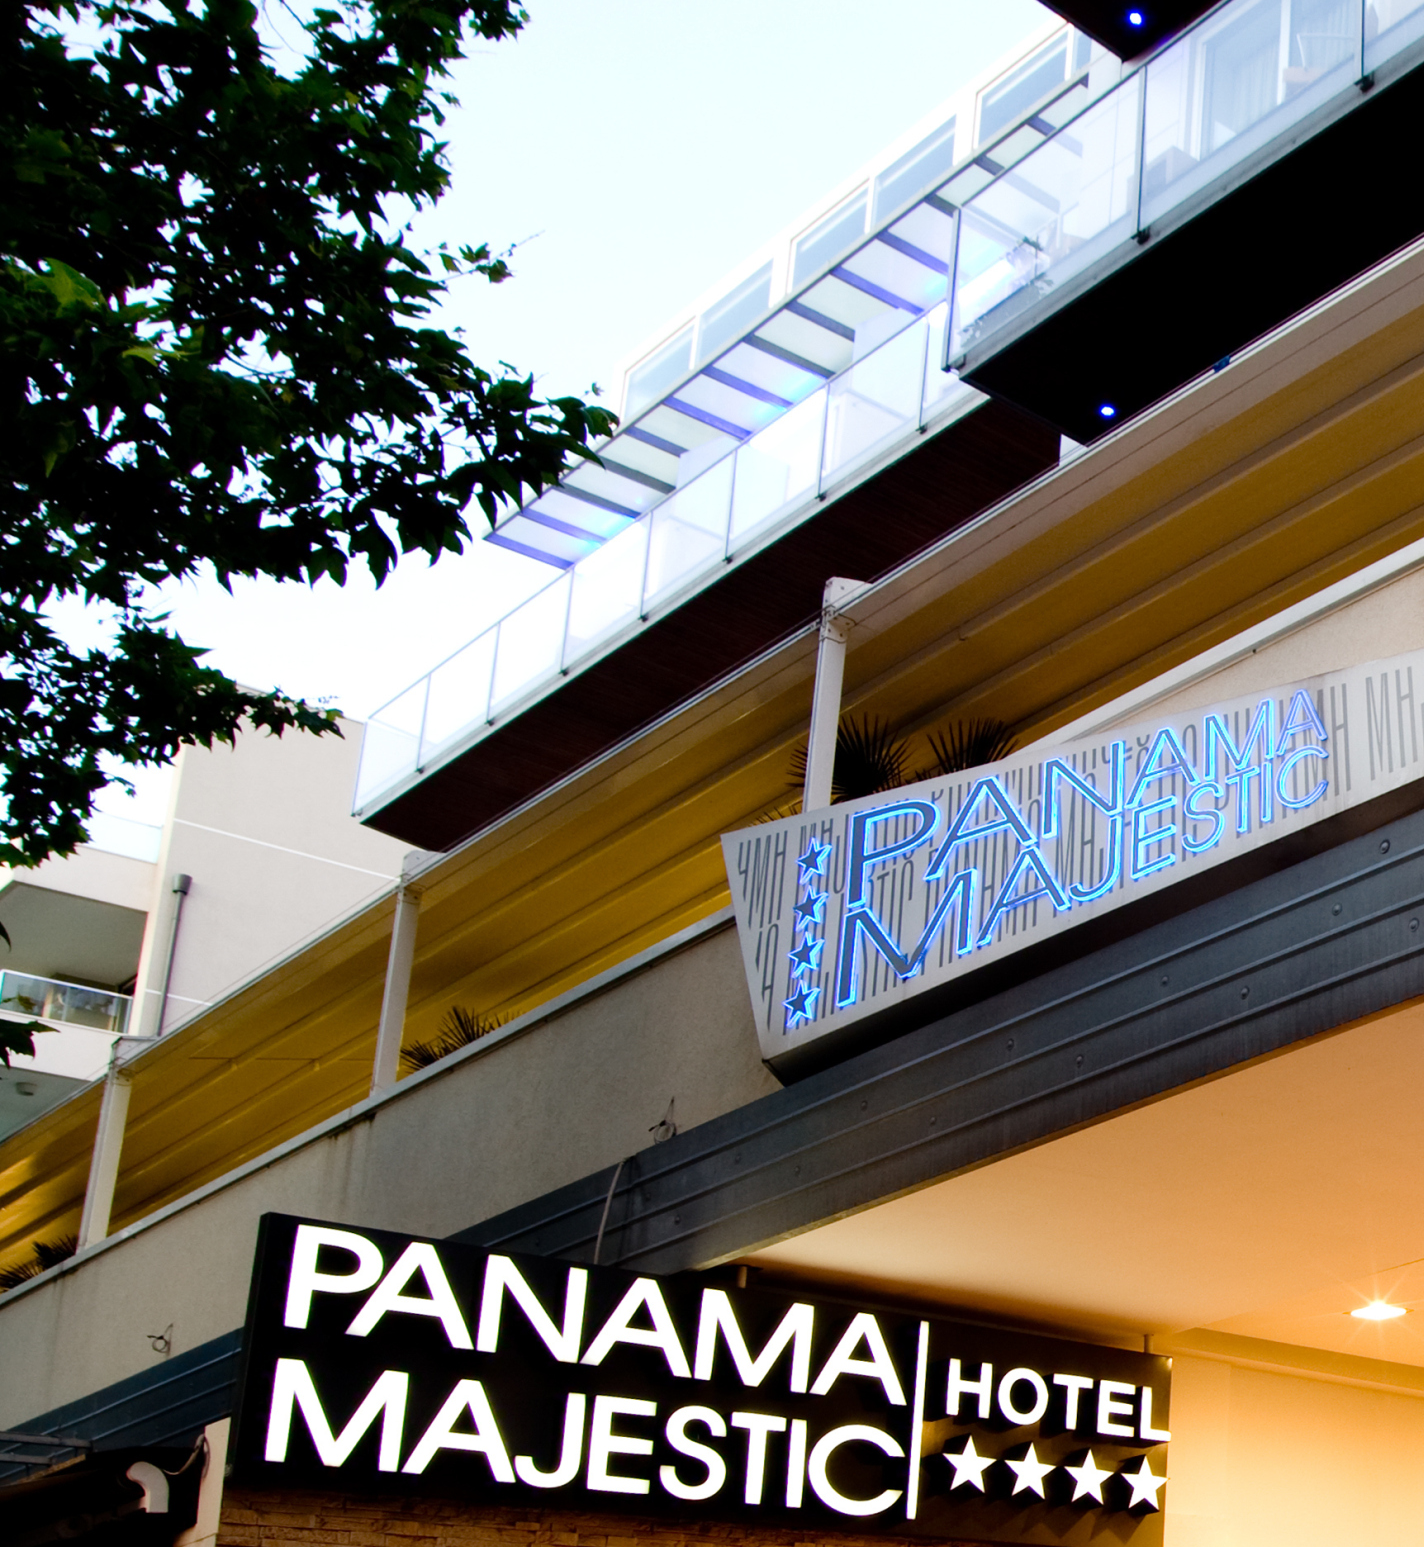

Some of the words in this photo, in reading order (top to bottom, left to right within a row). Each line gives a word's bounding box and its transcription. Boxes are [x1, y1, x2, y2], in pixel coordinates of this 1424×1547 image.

[835, 744, 1329, 1008] MAJESTIC
[844, 688, 1329, 908] PANAMA
[283, 1224, 906, 1406] PANAMA
[945, 1358, 1172, 1443] HOTEL
[264, 1358, 906, 1517] MAJESTIC
